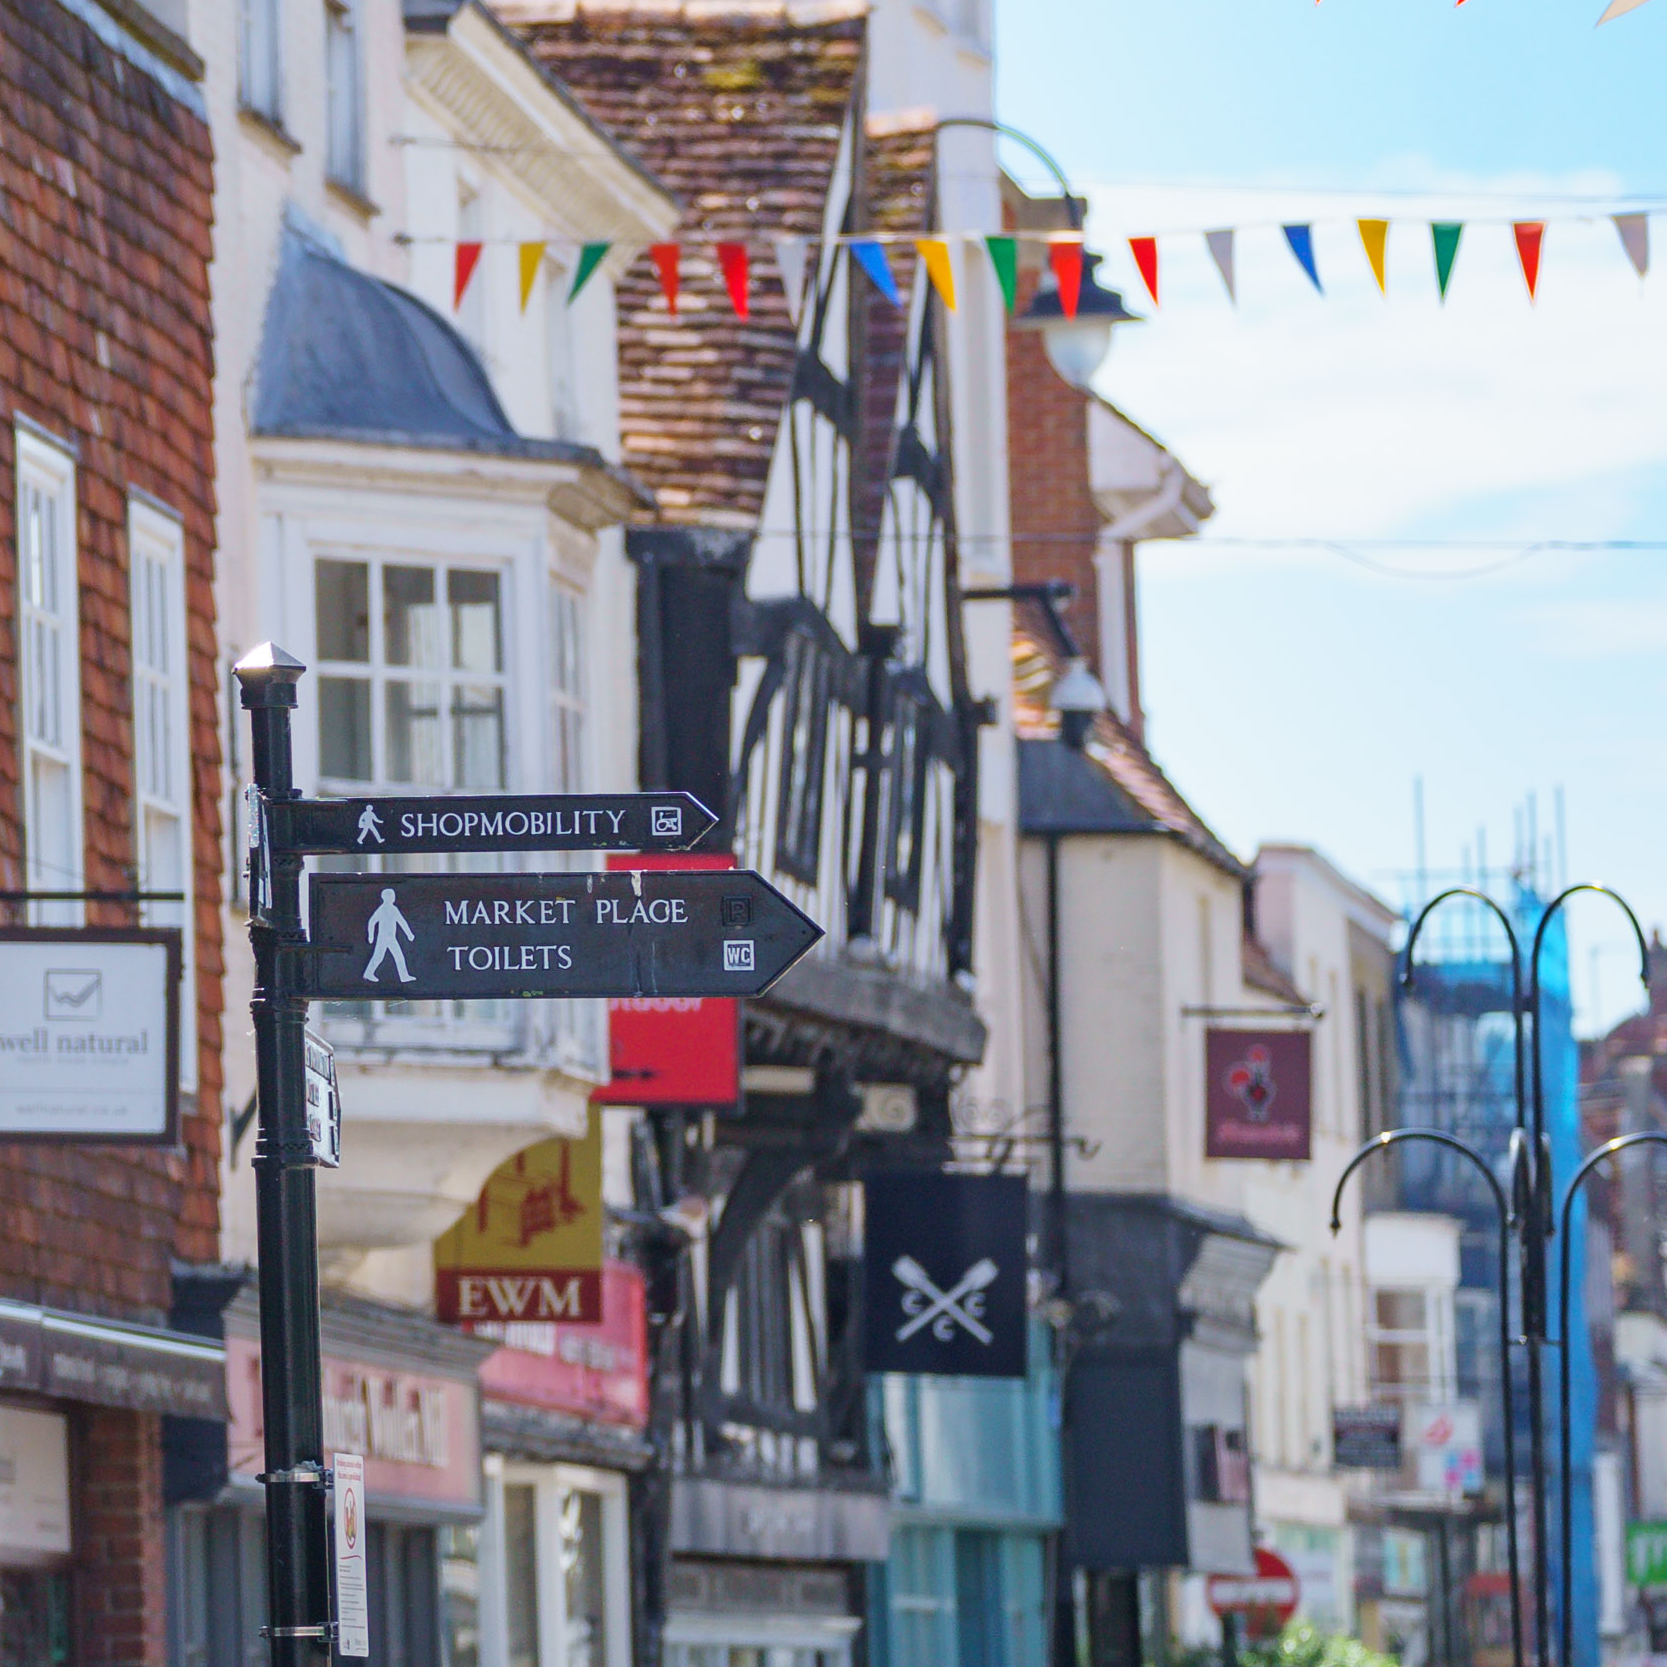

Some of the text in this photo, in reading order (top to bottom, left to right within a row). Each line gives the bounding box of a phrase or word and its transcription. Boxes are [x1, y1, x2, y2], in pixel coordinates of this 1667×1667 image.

[400, 806, 627, 840] SHOPMOBILITY
[445, 898, 576, 927] MARKET
[595, 898, 689, 925] PLACE
[447, 944, 751, 973] TOILETS WC
[56, 1028, 149, 1055] natural
[458, 1275, 583, 1318] EWM
